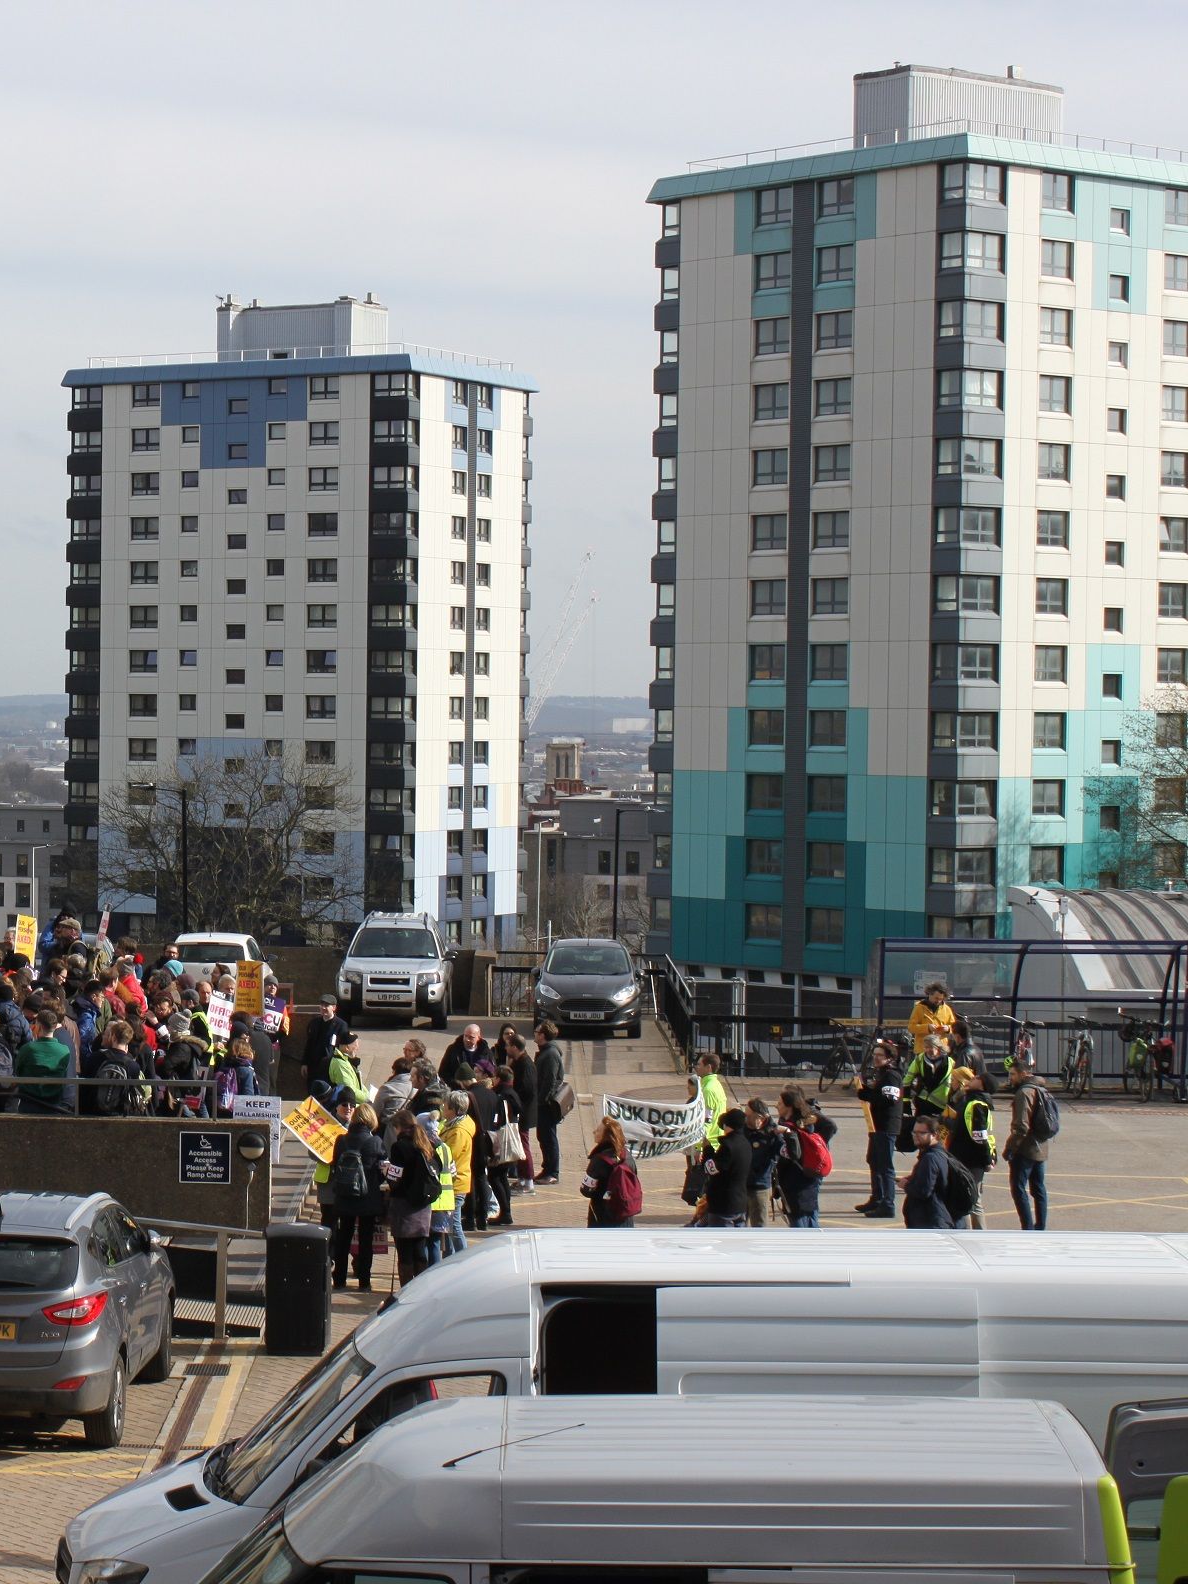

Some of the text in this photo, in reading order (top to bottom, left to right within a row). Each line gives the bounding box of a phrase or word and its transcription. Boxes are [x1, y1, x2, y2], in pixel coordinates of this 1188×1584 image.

[245, 1100, 271, 1108] KEEP
[234, 1111, 280, 1119] HALLAMSHIRE
[288, 1114, 302, 1126] OUR
[651, 1126, 677, 1138] WE
[186, 1171, 205, 1179] Ramp
